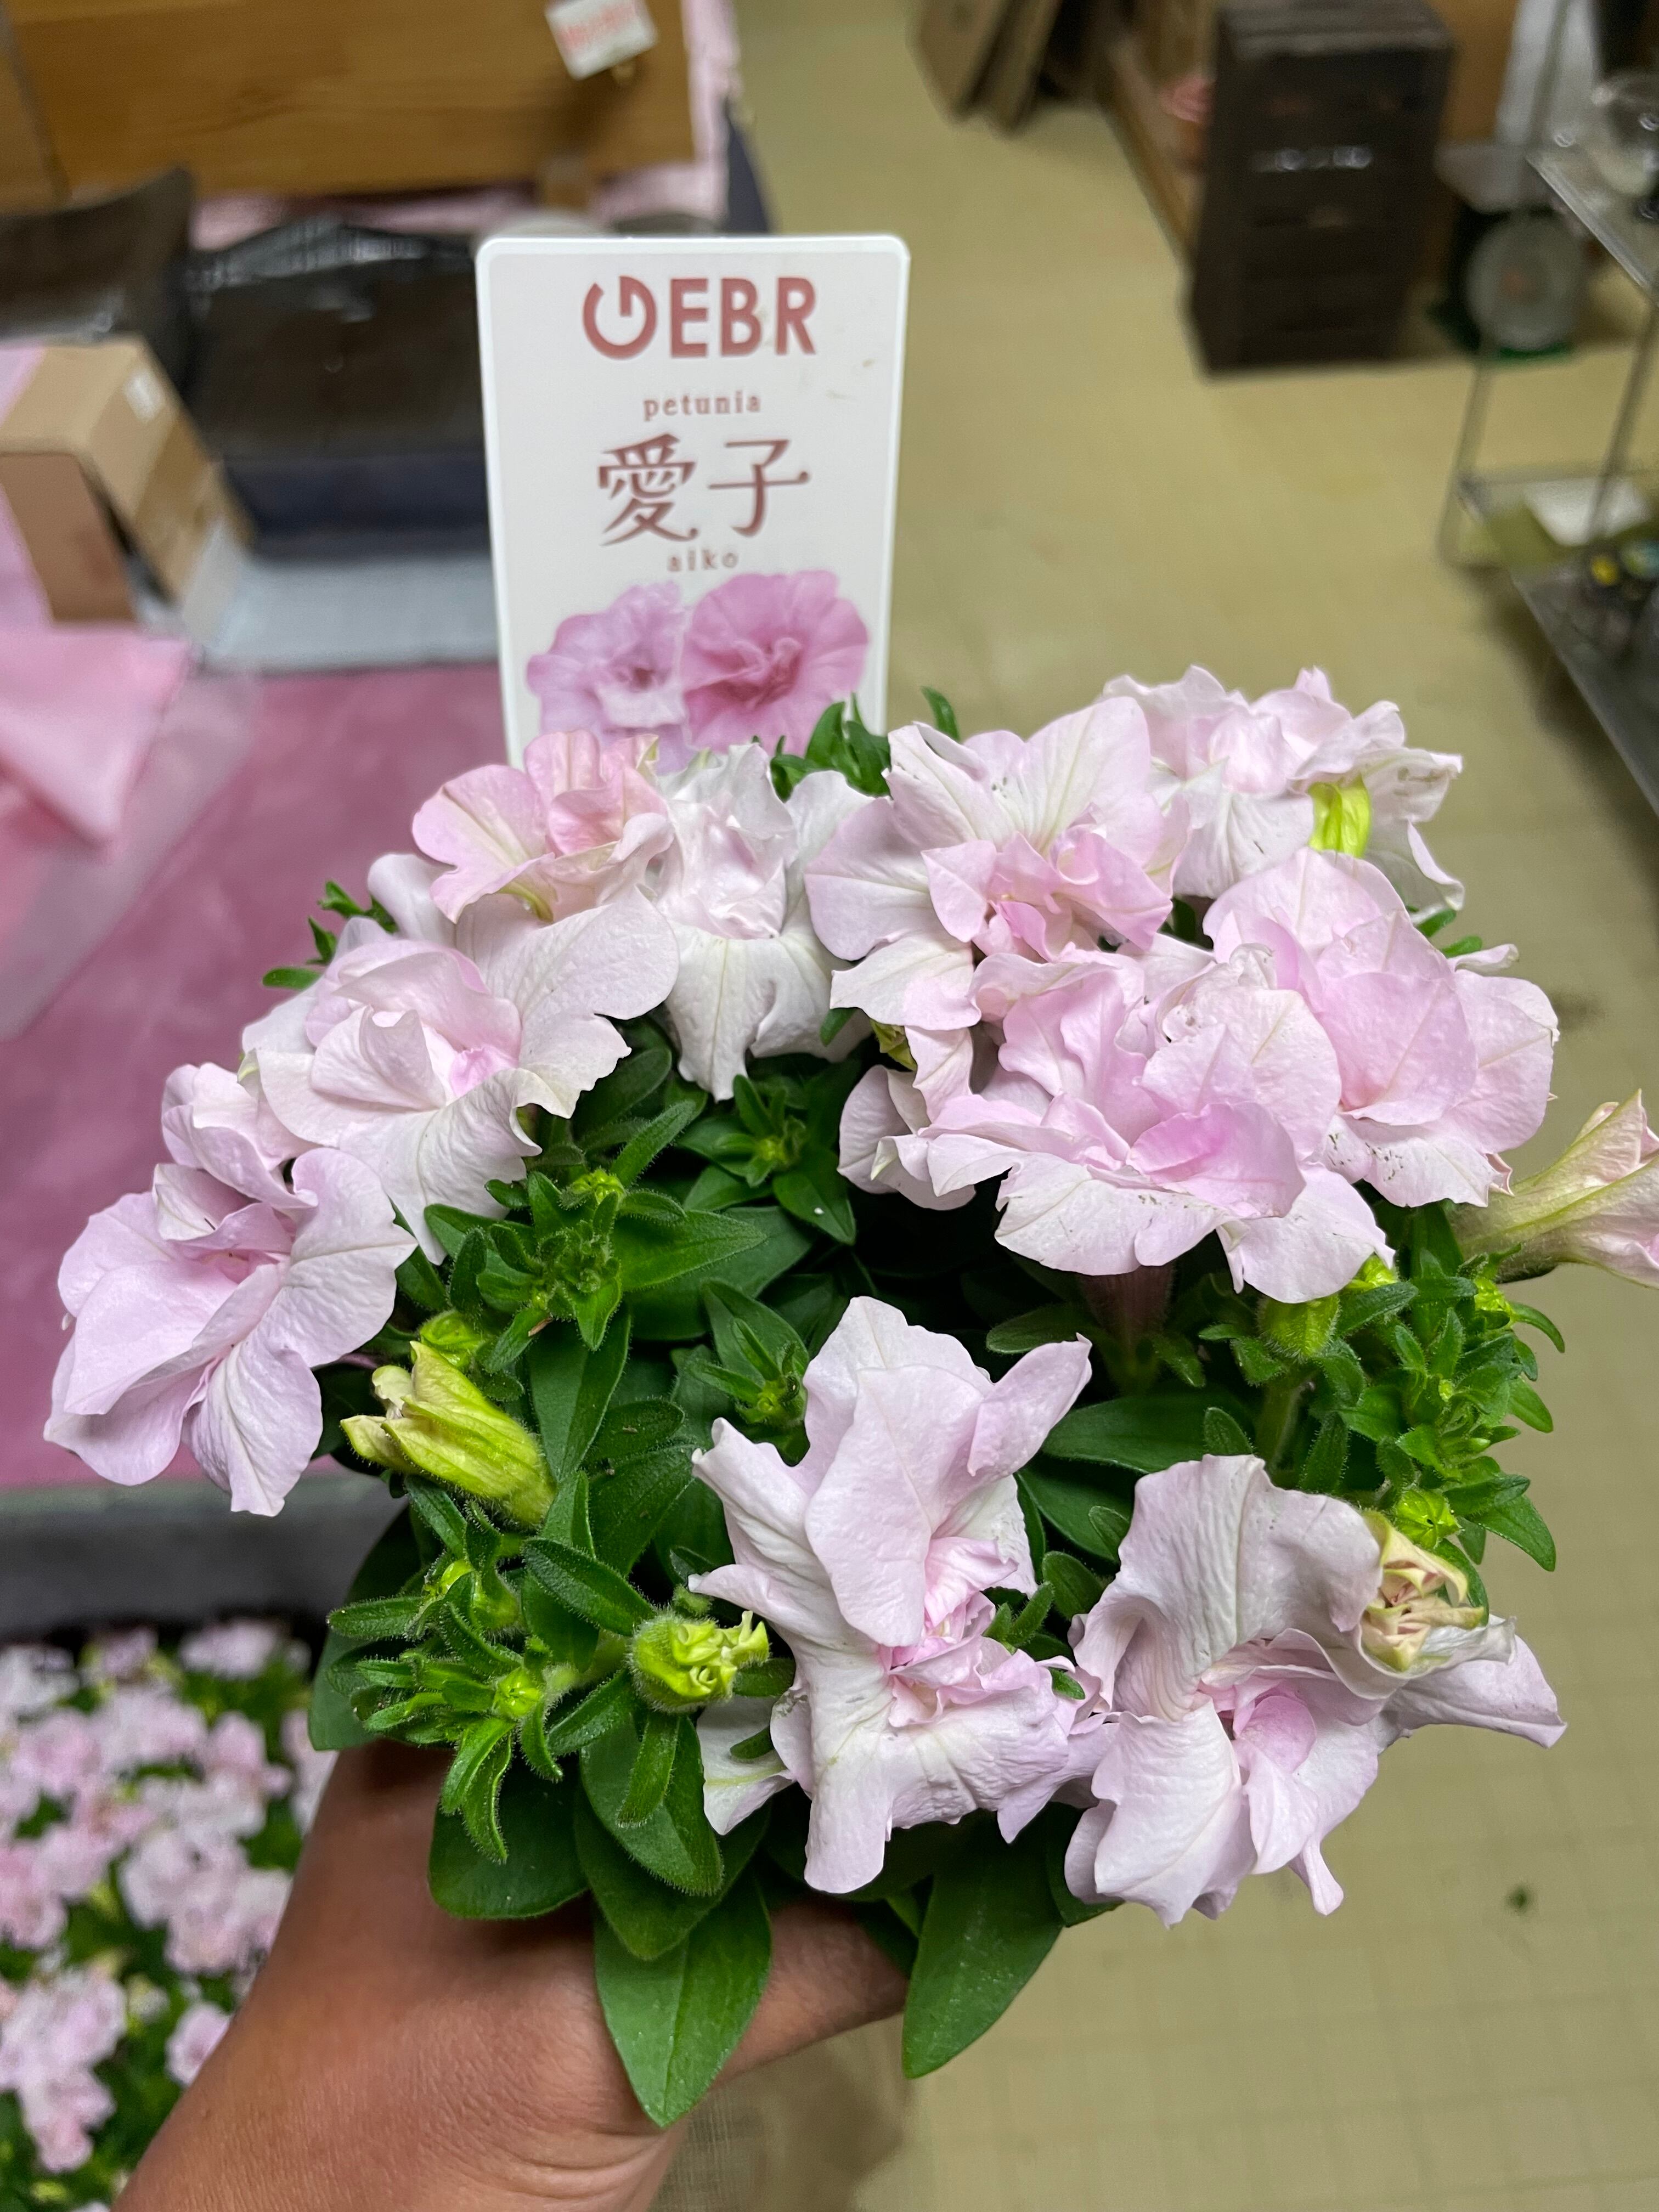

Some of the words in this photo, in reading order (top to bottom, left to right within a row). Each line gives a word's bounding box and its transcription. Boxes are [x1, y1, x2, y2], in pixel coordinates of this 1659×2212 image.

[643, 390, 762, 421] petunia
[598, 433, 810, 546] 愛子
[668, 549, 740, 572] aiko
